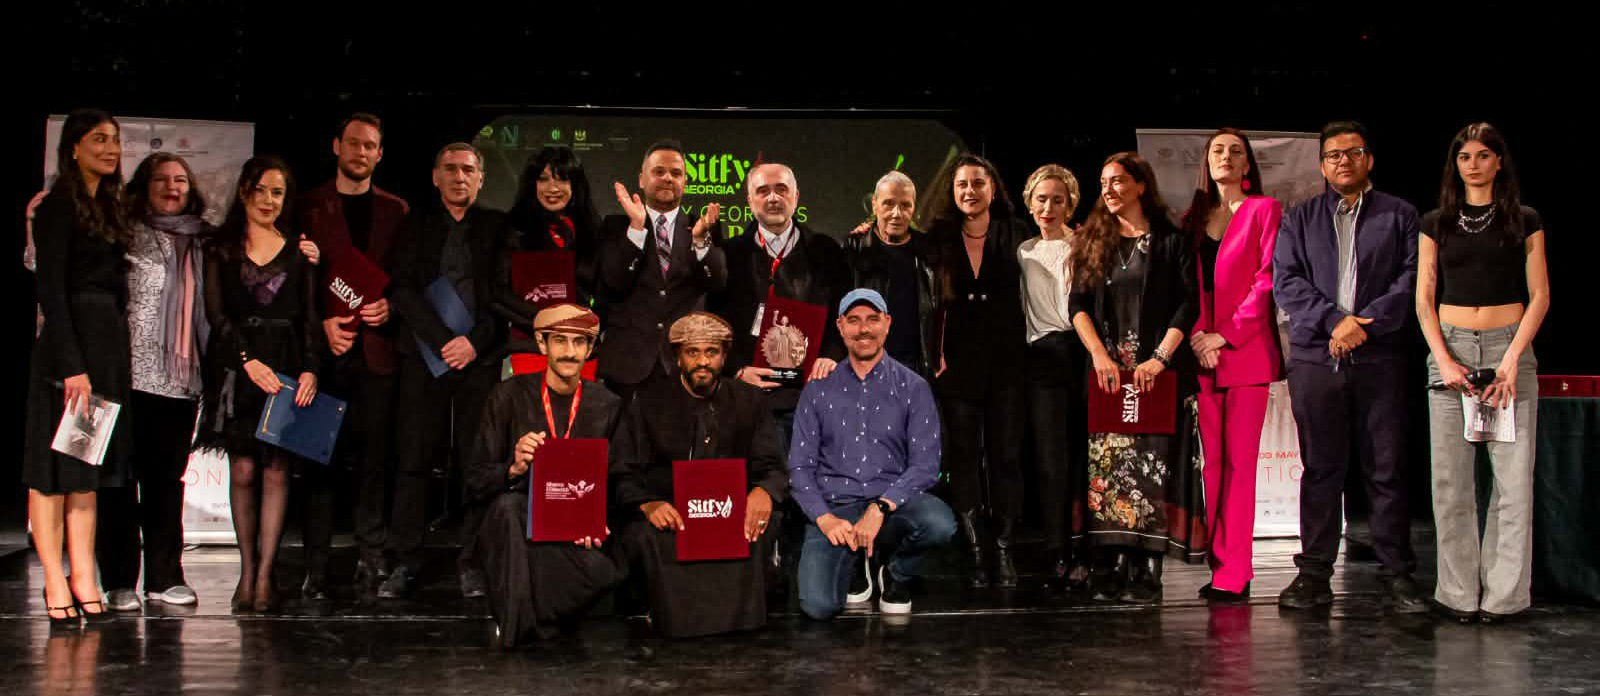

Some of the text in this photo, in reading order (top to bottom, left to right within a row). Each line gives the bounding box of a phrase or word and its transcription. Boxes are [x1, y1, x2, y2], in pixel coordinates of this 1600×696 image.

[684, 153, 750, 190] Sitfy
[684, 184, 736, 194] GEORGIA
[687, 499, 724, 515] Sitfy
